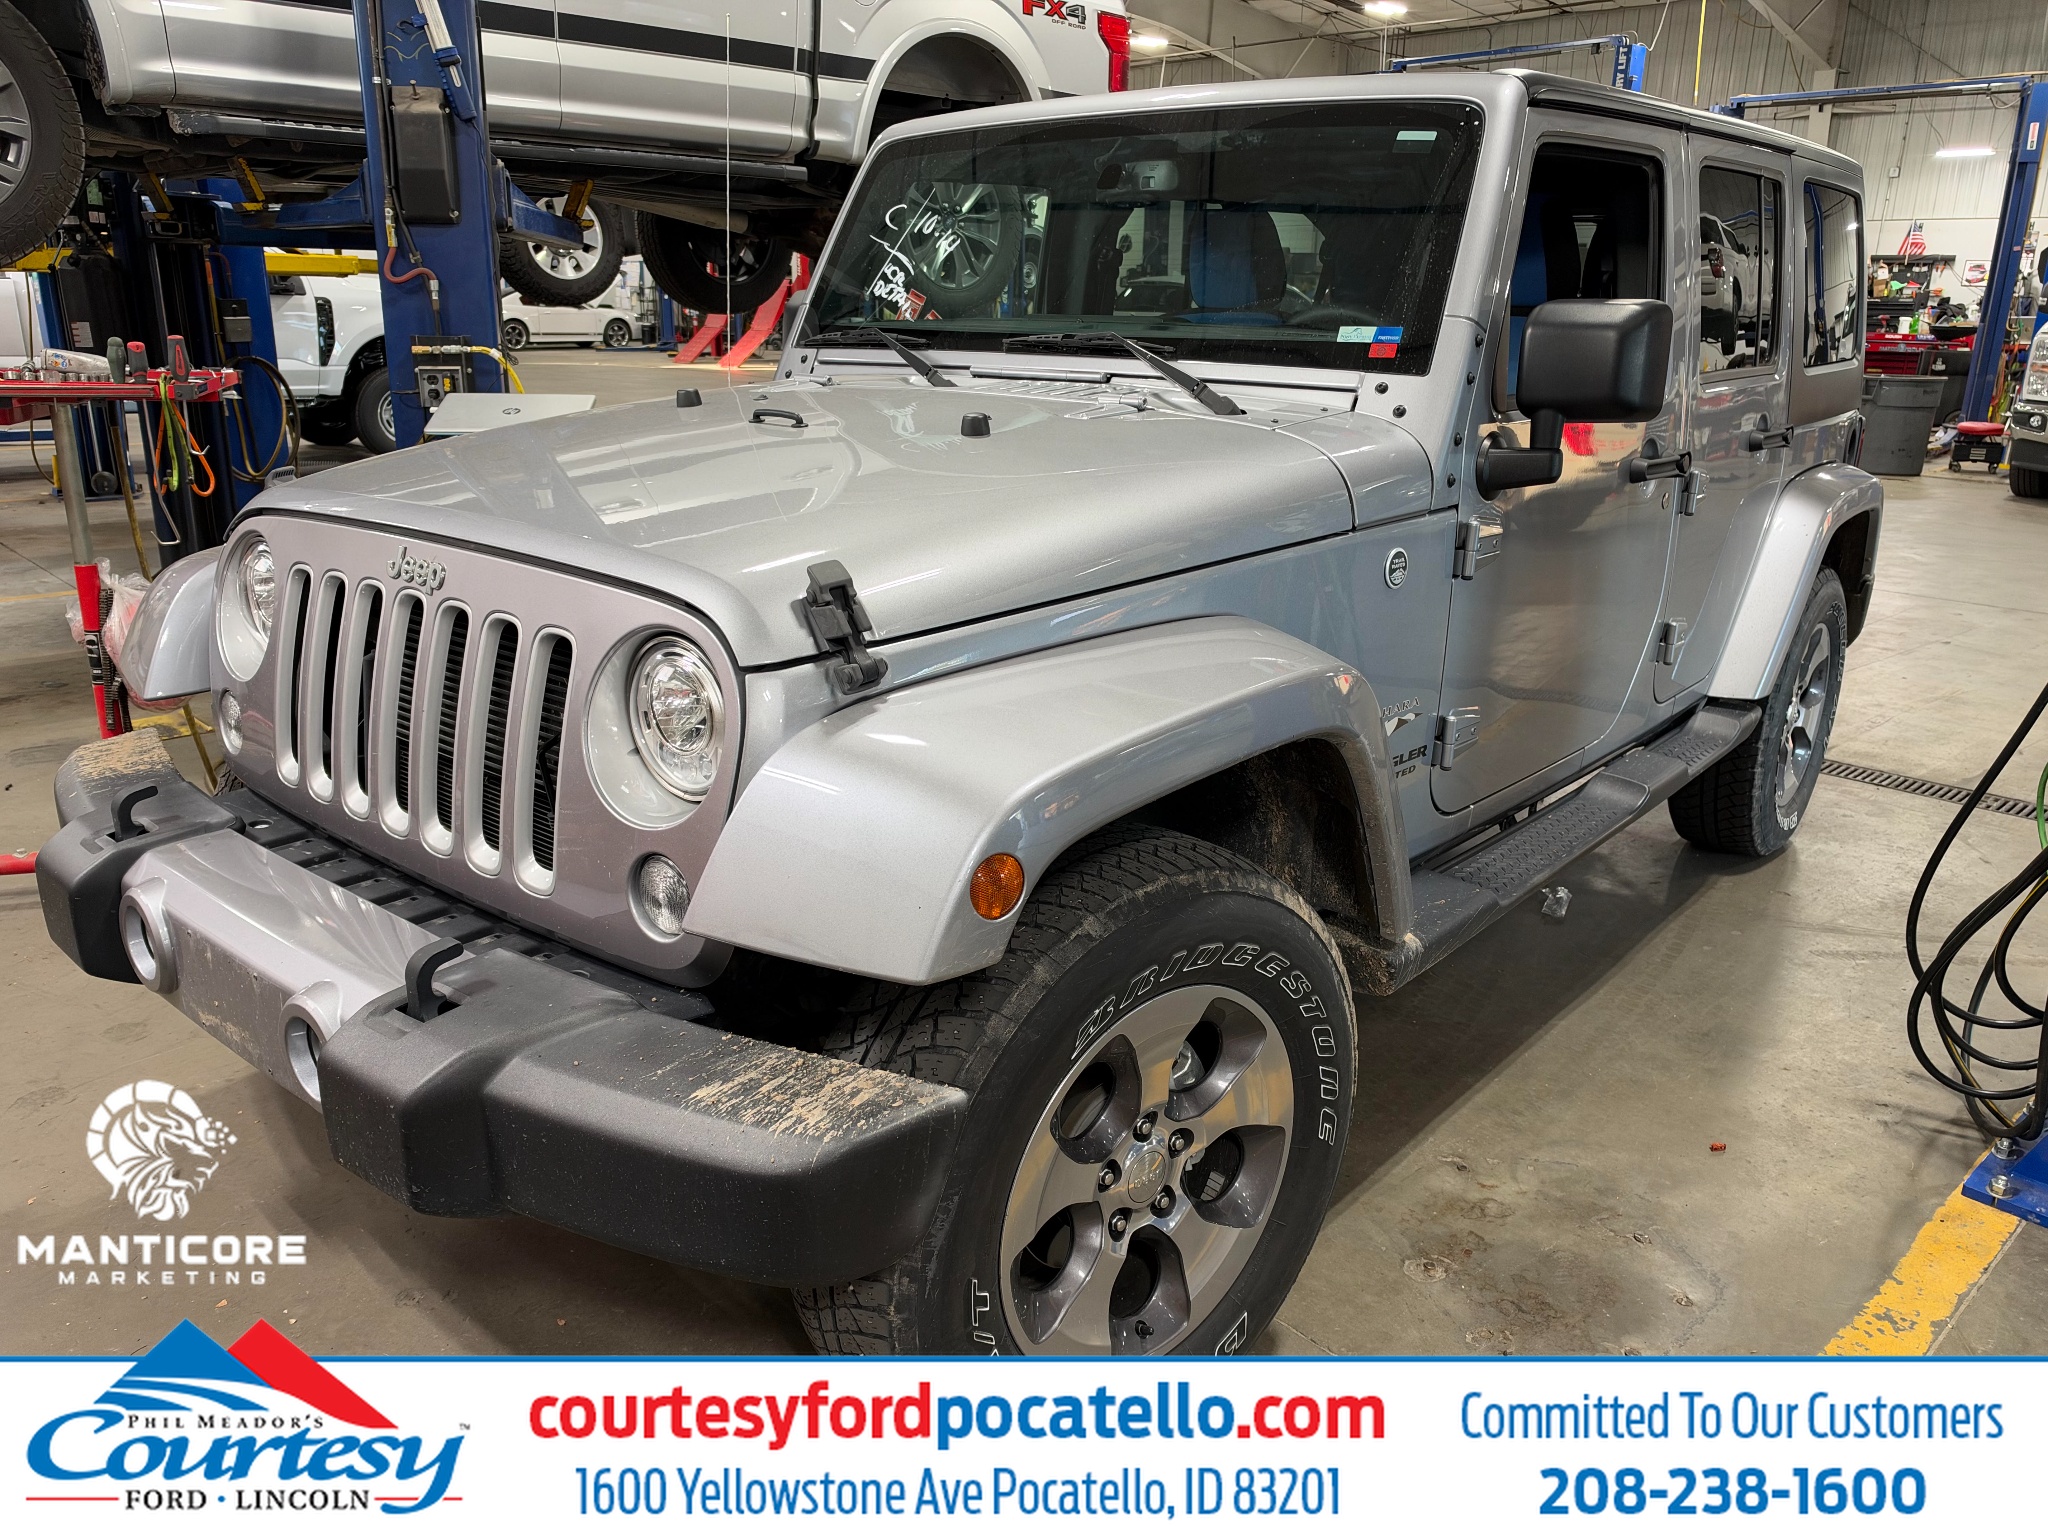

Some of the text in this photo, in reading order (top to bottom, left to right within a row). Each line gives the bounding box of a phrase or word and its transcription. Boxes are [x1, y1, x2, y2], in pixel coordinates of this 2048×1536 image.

[1023, 0, 1087, 25] FX4
[1051, 18, 1087, 31] OFF ROAD
[1618, 46, 1628, 70] LIFT
[386, 545, 447, 596] Jeep
[1382, 696, 1421, 719] HARA
[1071, 943, 1339, 1146] BRIDGESTONE
